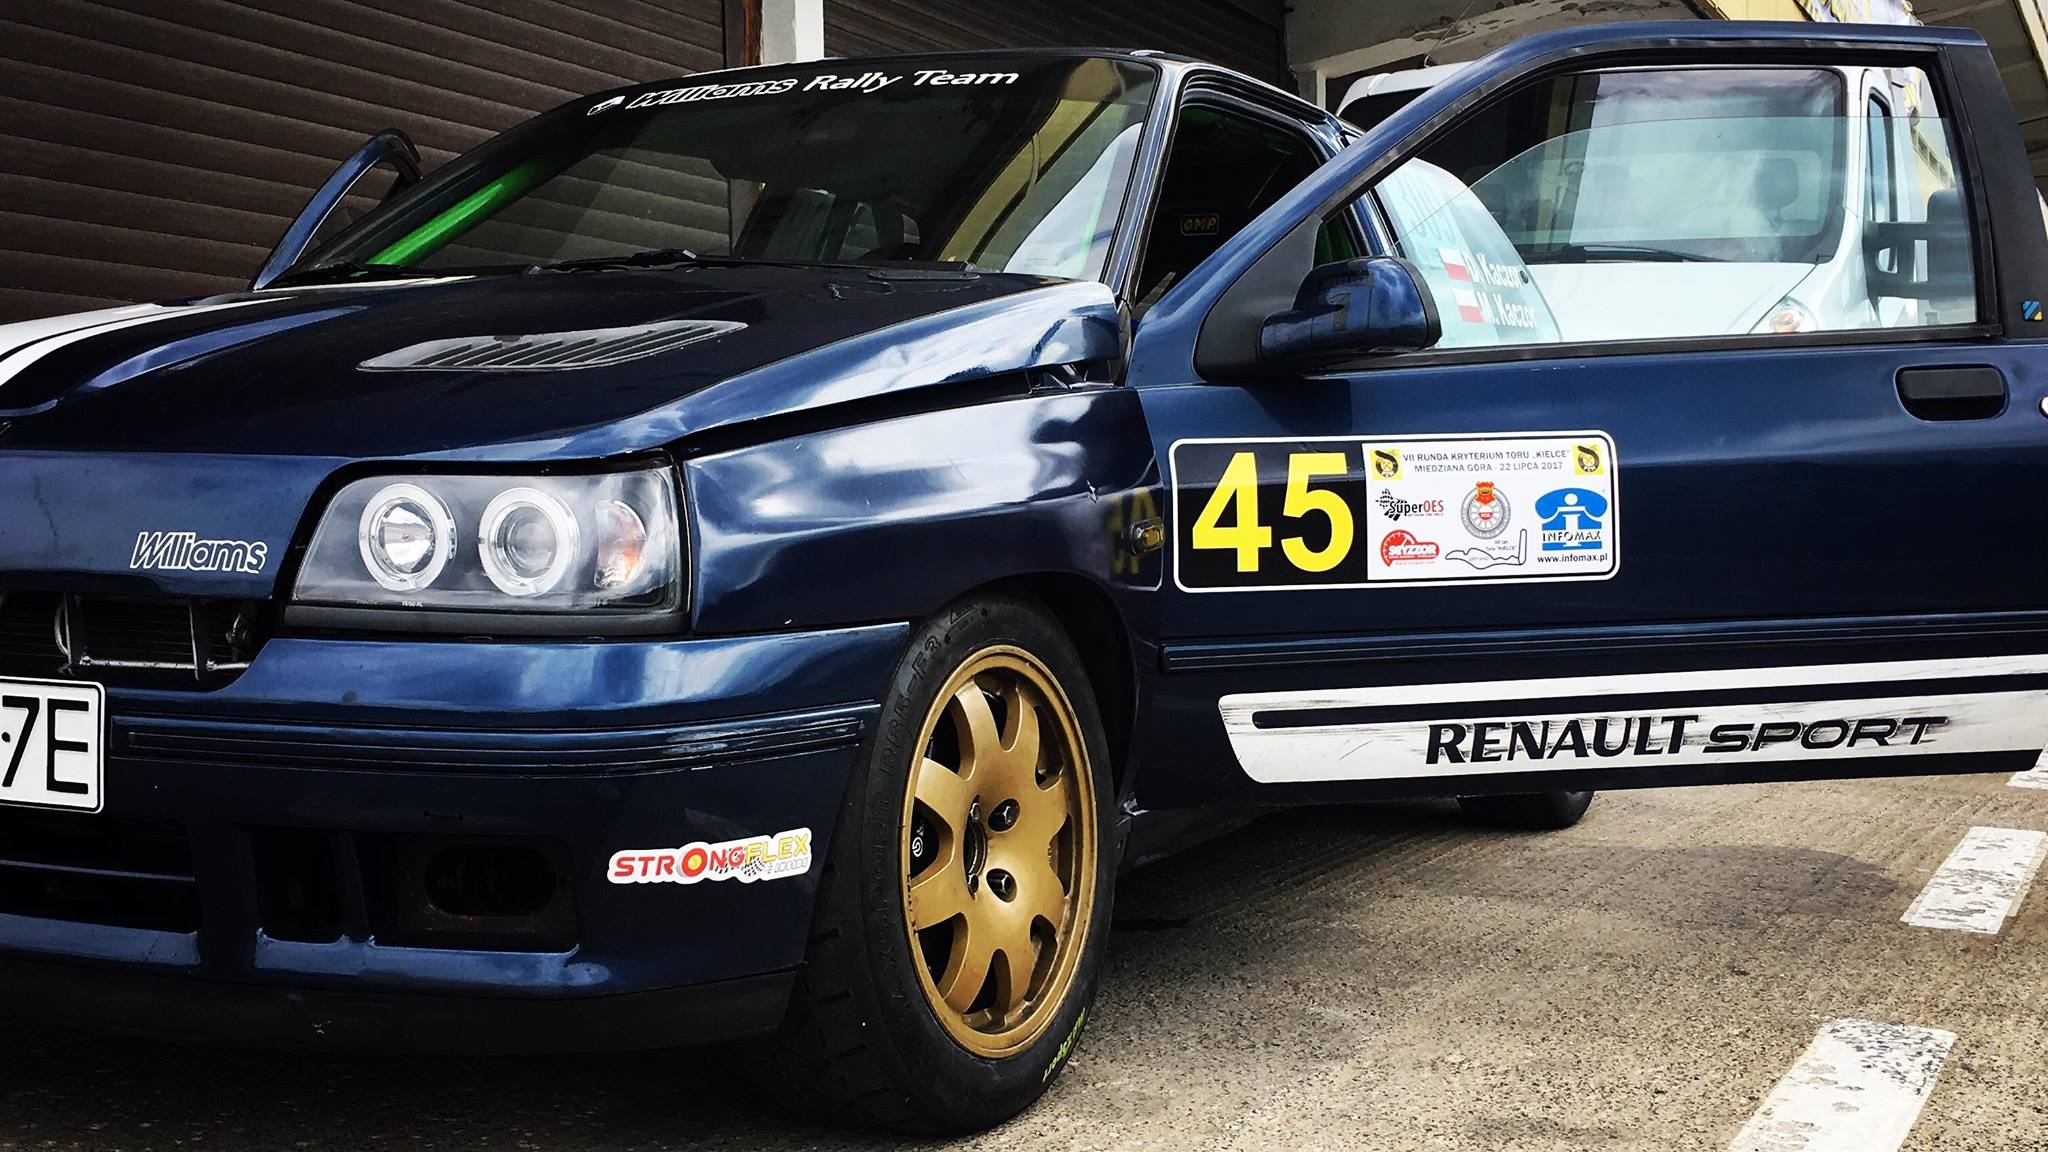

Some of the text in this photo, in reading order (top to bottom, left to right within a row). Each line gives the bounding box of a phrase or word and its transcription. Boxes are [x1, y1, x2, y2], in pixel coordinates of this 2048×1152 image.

[802, 72, 904, 94] Rally
[912, 69, 1020, 86] Team
[1476, 252, 1525, 289] Kaczor
[1493, 293, 1537, 329] Kaczor
[1402, 453, 1415, 462] VII
[1417, 452, 1449, 462] RUNDA
[1450, 451, 1504, 461] KRYTERIUM
[1506, 450, 1530, 459] TORU
[1414, 463, 1465, 473] MIEDZIANA
[1499, 463, 1512, 471] 22
[1513, 461, 1540, 471] LIPCA
[1541, 460, 1564, 470] 2017
[1192, 451, 1355, 574] 45
[1389, 499, 1445, 517] SuperOES
[129, 531, 268, 574] Williams
[1542, 530, 1602, 542] INFOMAX
[1537, 552, 1608, 563] www.infomax.pl
[2, 694, 90, 795] 7E
[1425, 714, 1949, 765] RENAULT SPORT
[614, 833, 809, 878] STRONGFLEX
